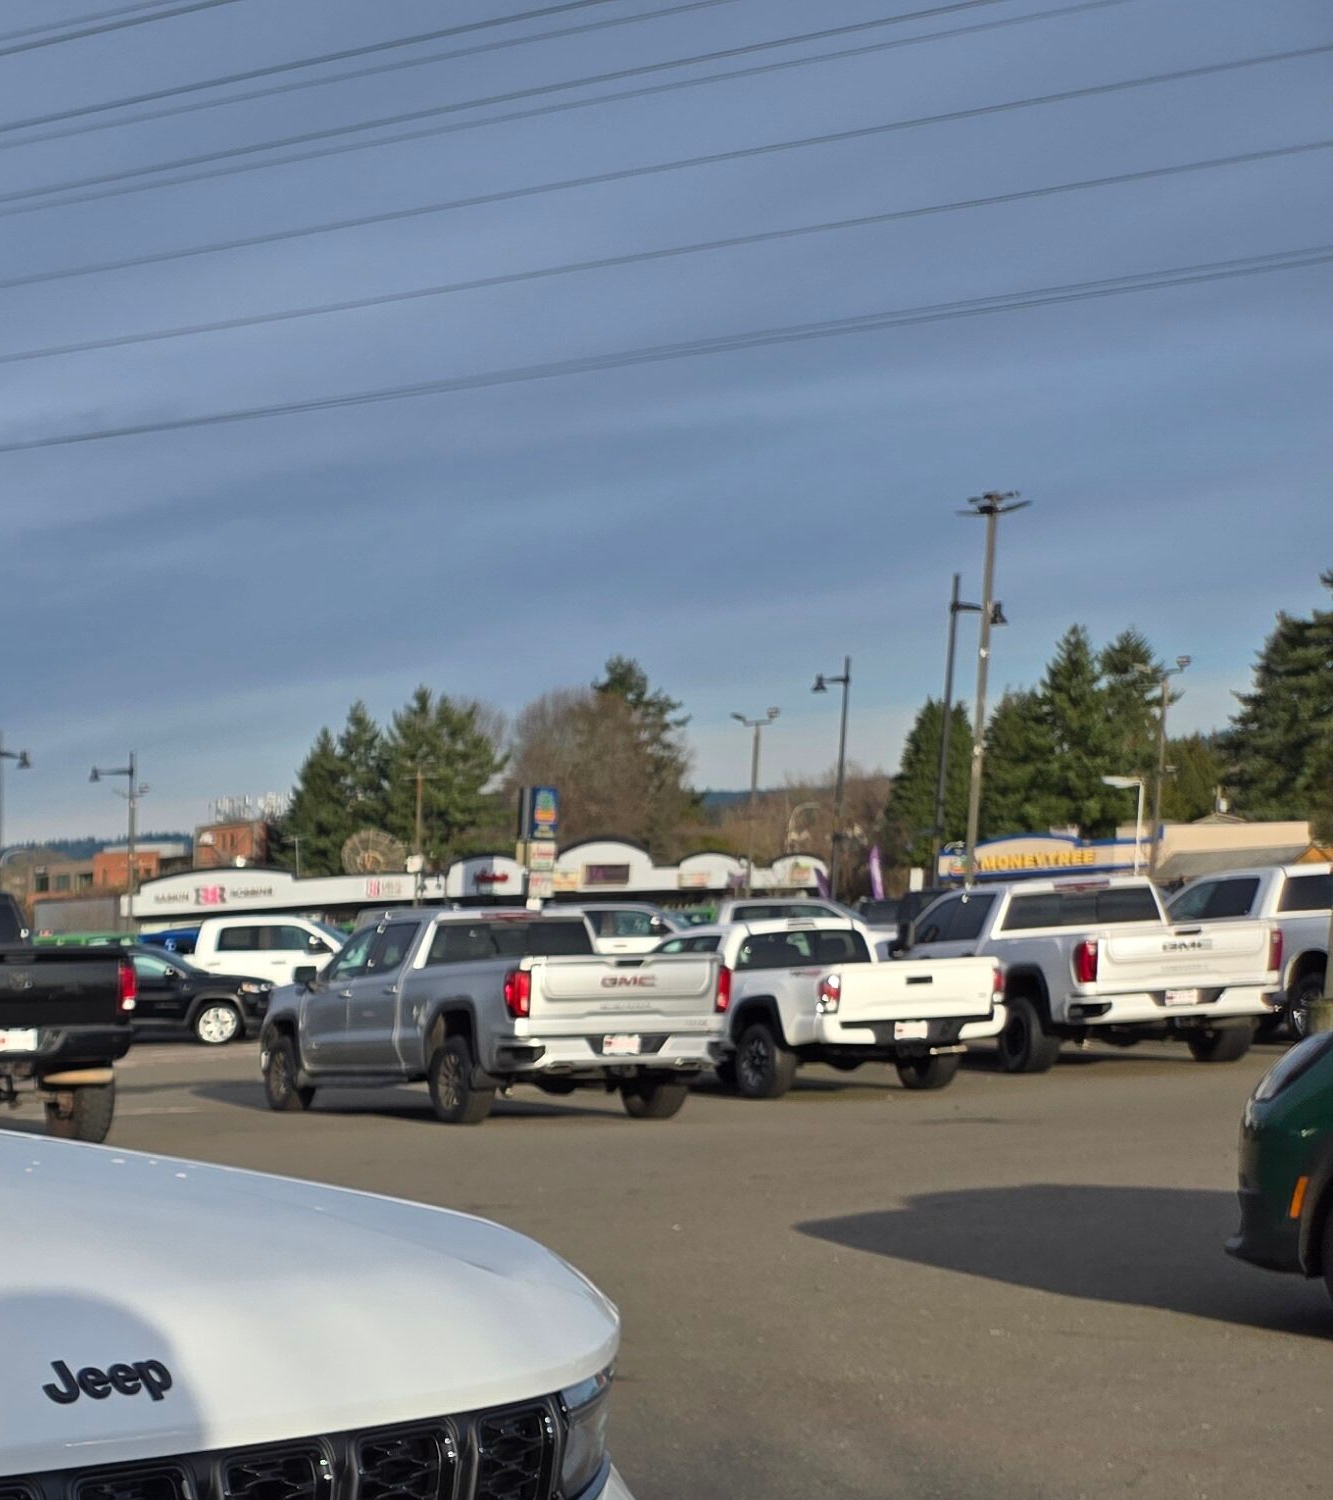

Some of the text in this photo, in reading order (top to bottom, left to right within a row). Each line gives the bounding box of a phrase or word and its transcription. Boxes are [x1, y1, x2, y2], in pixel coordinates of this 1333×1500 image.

[981, 851, 1094, 872] MONEYTREE
[601, 975, 657, 988] GMC
[43, 1359, 173, 1404] Jeep
